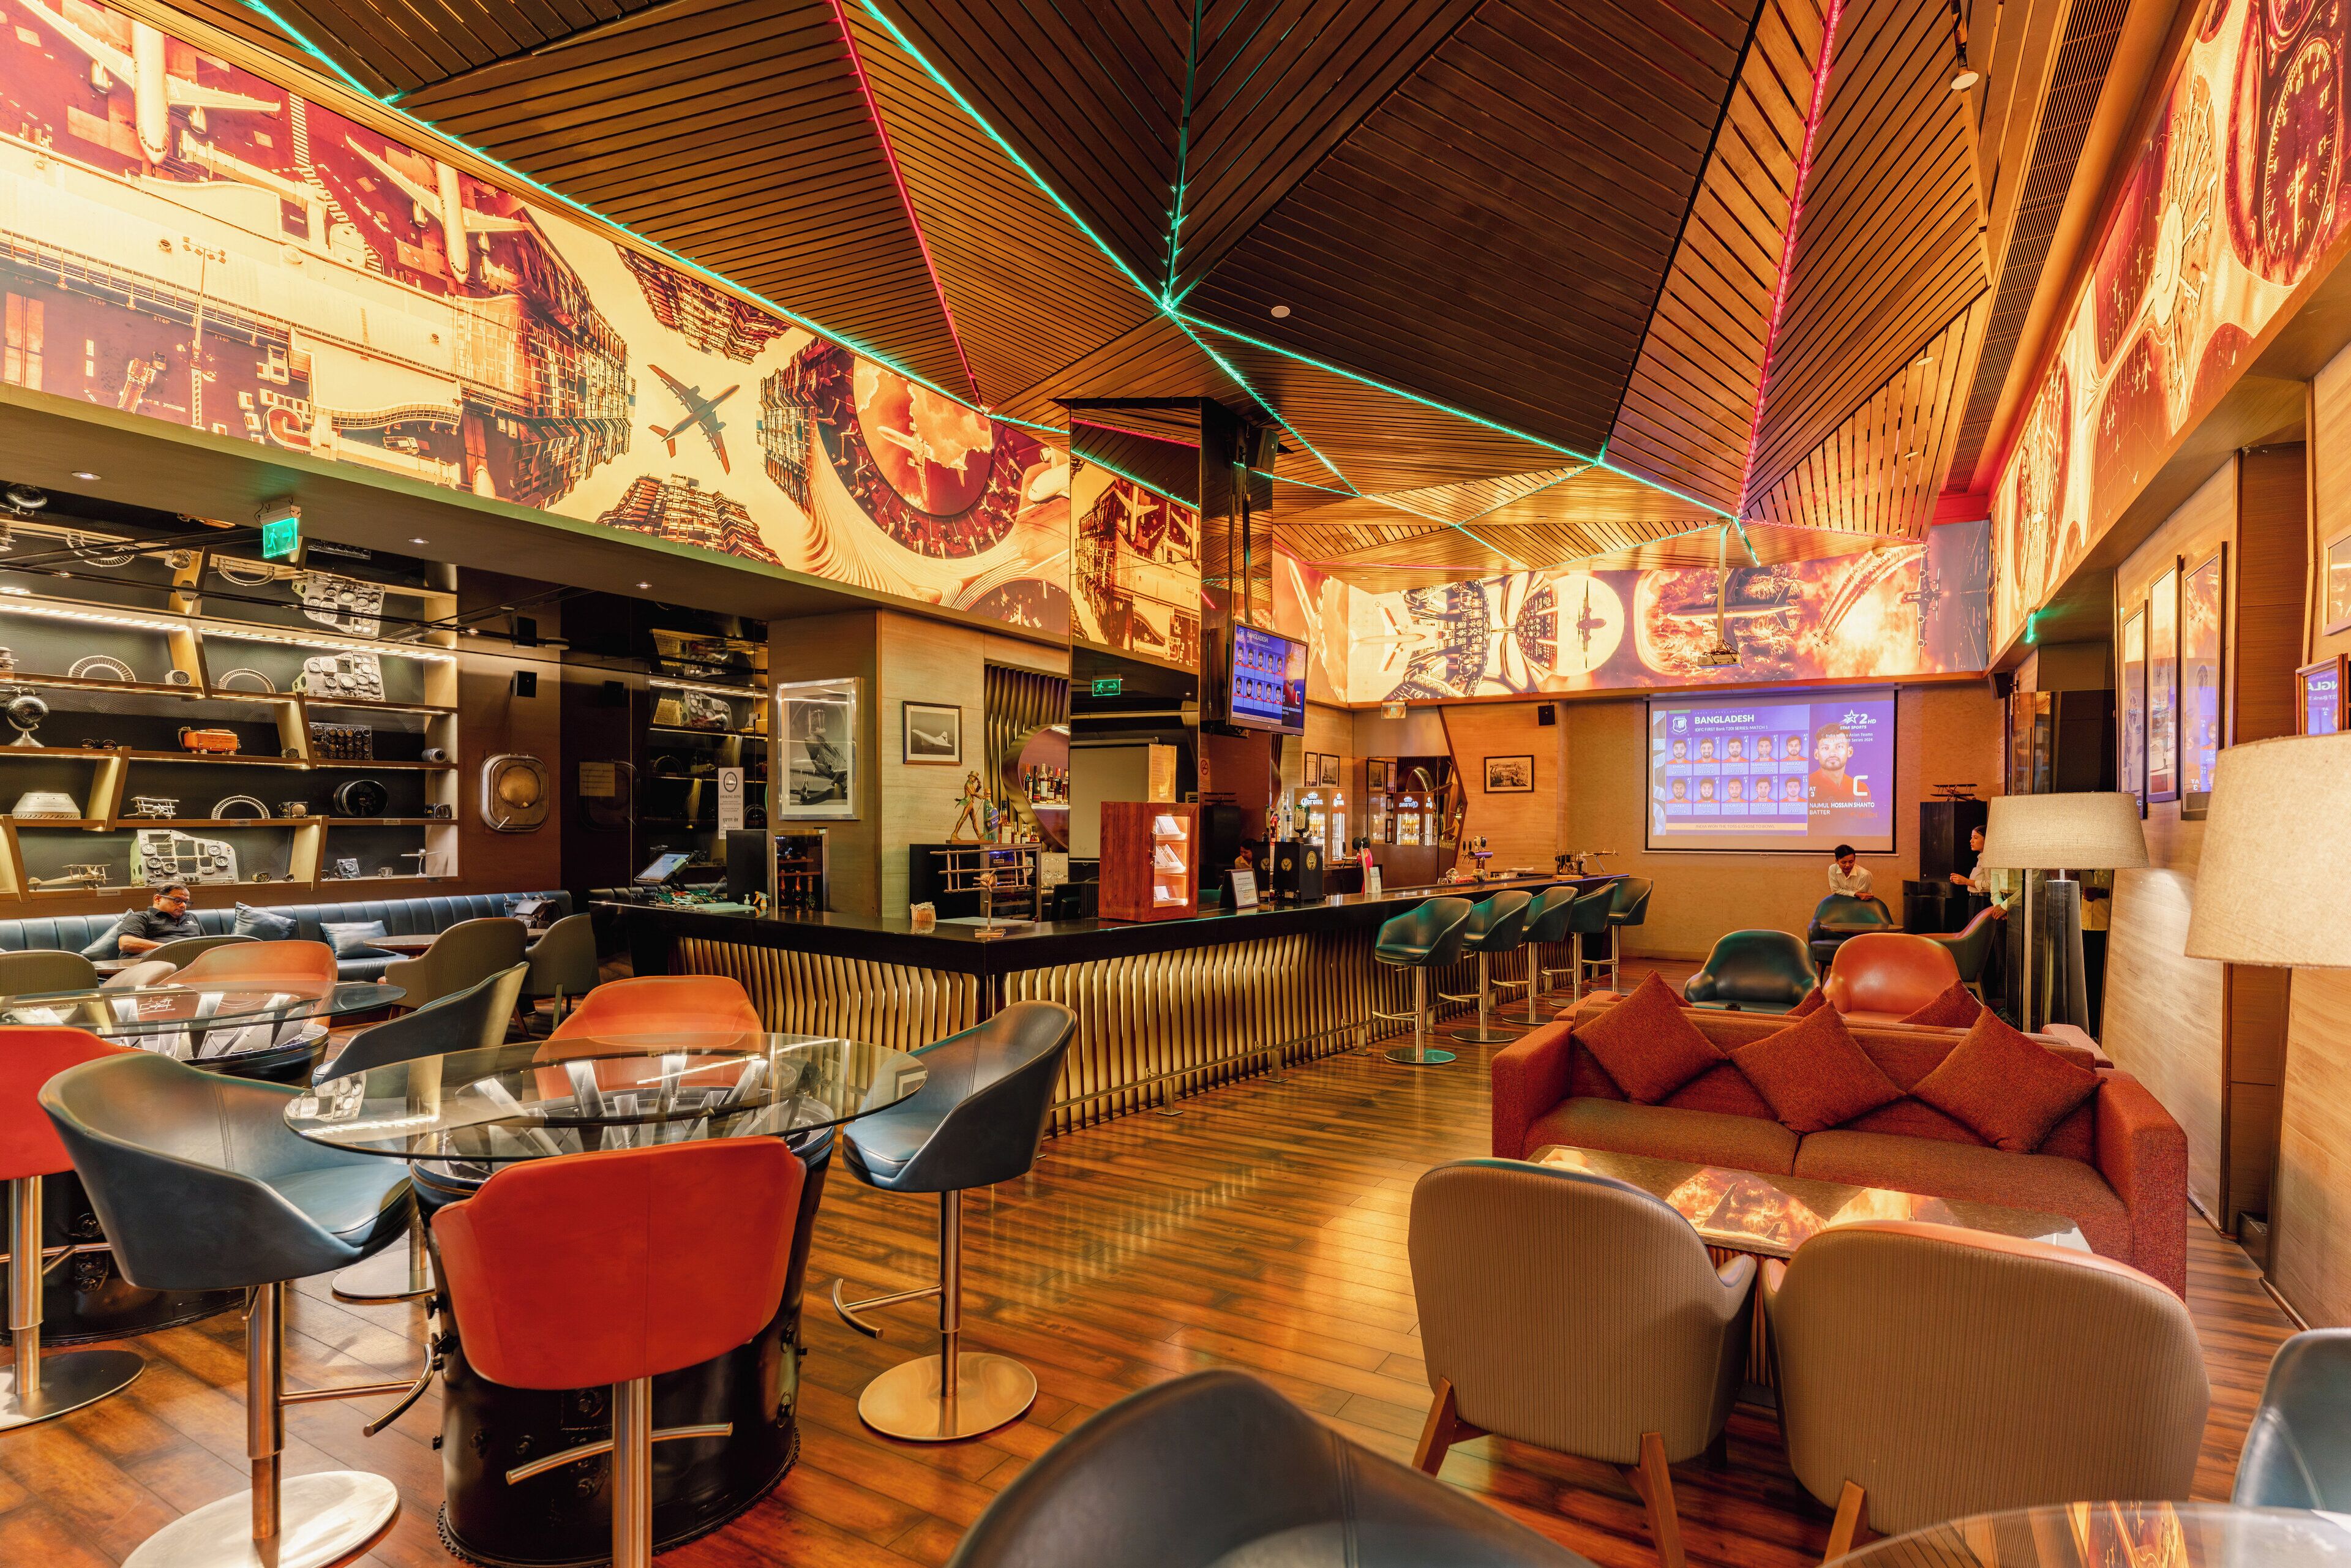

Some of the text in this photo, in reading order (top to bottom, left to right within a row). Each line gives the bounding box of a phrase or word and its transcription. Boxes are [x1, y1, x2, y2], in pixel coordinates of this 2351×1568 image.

[88, 297, 107, 306] STOP
[153, 315, 170, 324] STOP
[1247, 631, 1269, 643] BANGLADESH
[1694, 714, 1755, 724] BANGLADESH
[1859, 713, 1868, 724] 2
[1853, 775, 1869, 797] C
